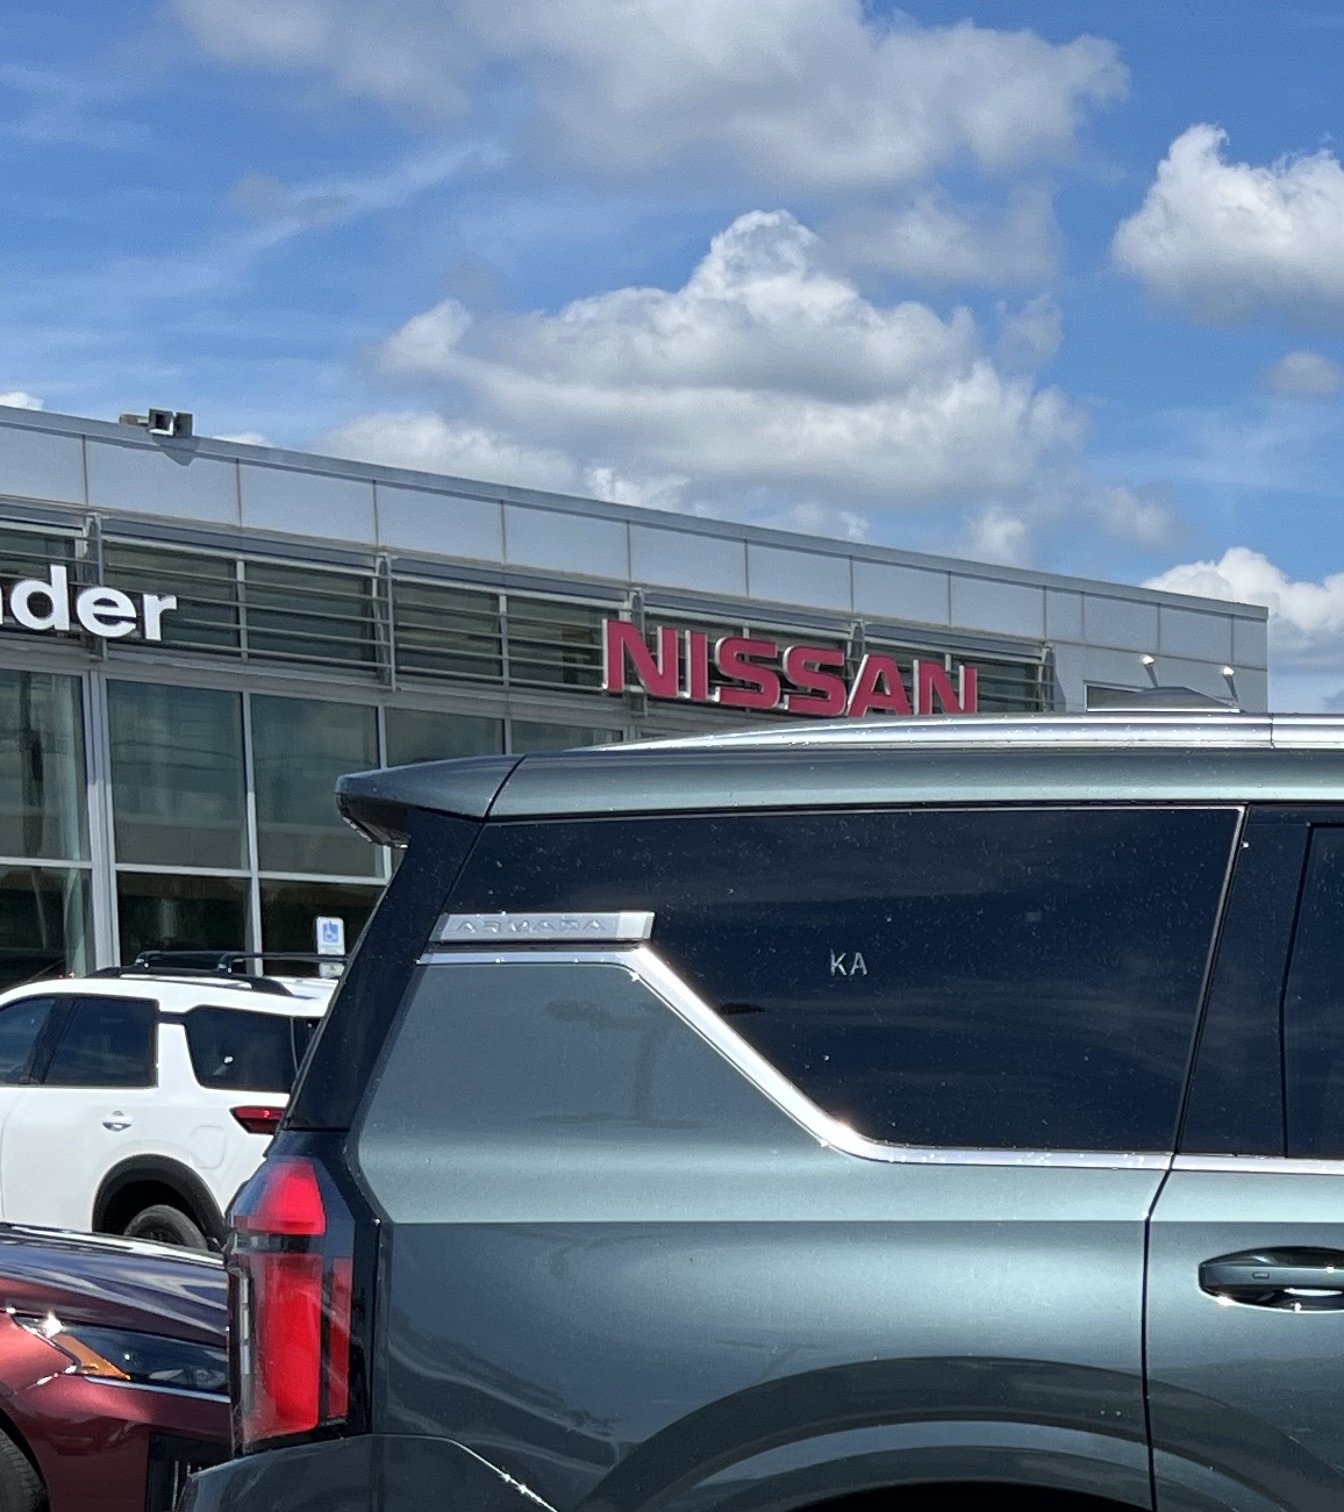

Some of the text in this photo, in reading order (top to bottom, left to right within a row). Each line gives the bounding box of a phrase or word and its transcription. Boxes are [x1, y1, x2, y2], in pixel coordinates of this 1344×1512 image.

[0, 563, 177, 642] der
[601, 618, 978, 718] NISSAN
[455, 917, 608, 934] ARMADA
[829, 947, 868, 976] KA
